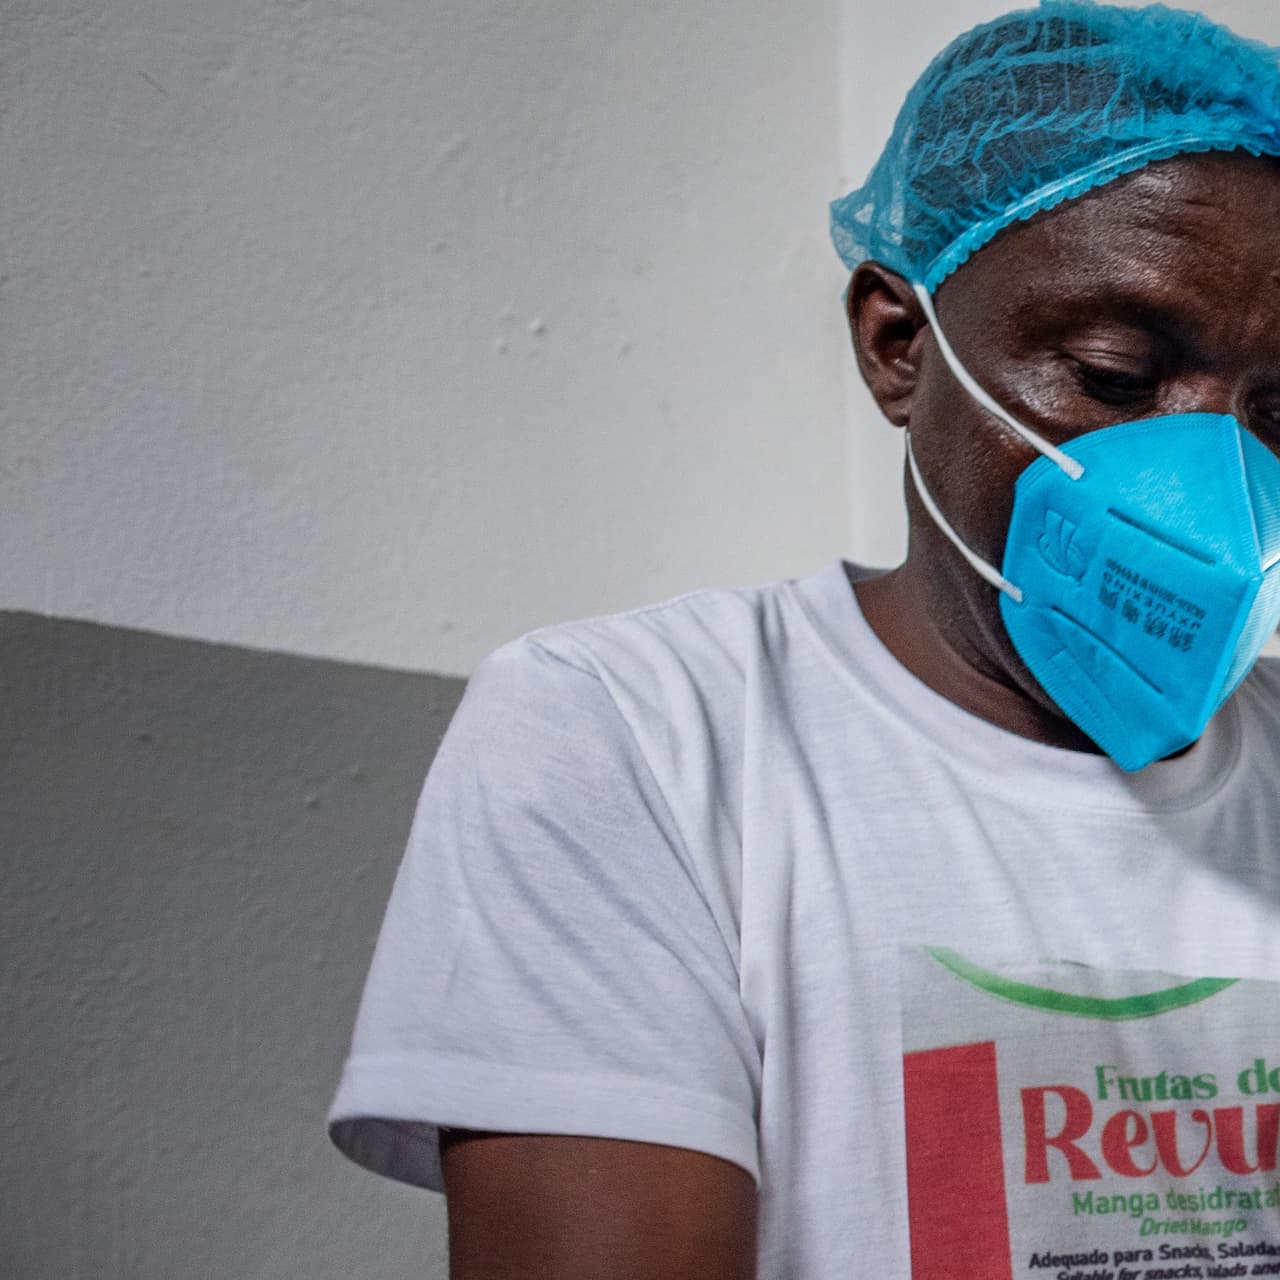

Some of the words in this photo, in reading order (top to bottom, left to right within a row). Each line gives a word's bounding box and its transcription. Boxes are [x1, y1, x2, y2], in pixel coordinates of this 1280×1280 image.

[1095, 1065, 1218, 1101] Frutas
[1072, 1191, 1158, 1218] Manga
[1029, 1249, 1109, 1270] Adequado
[1114, 1249, 1153, 1267] para
